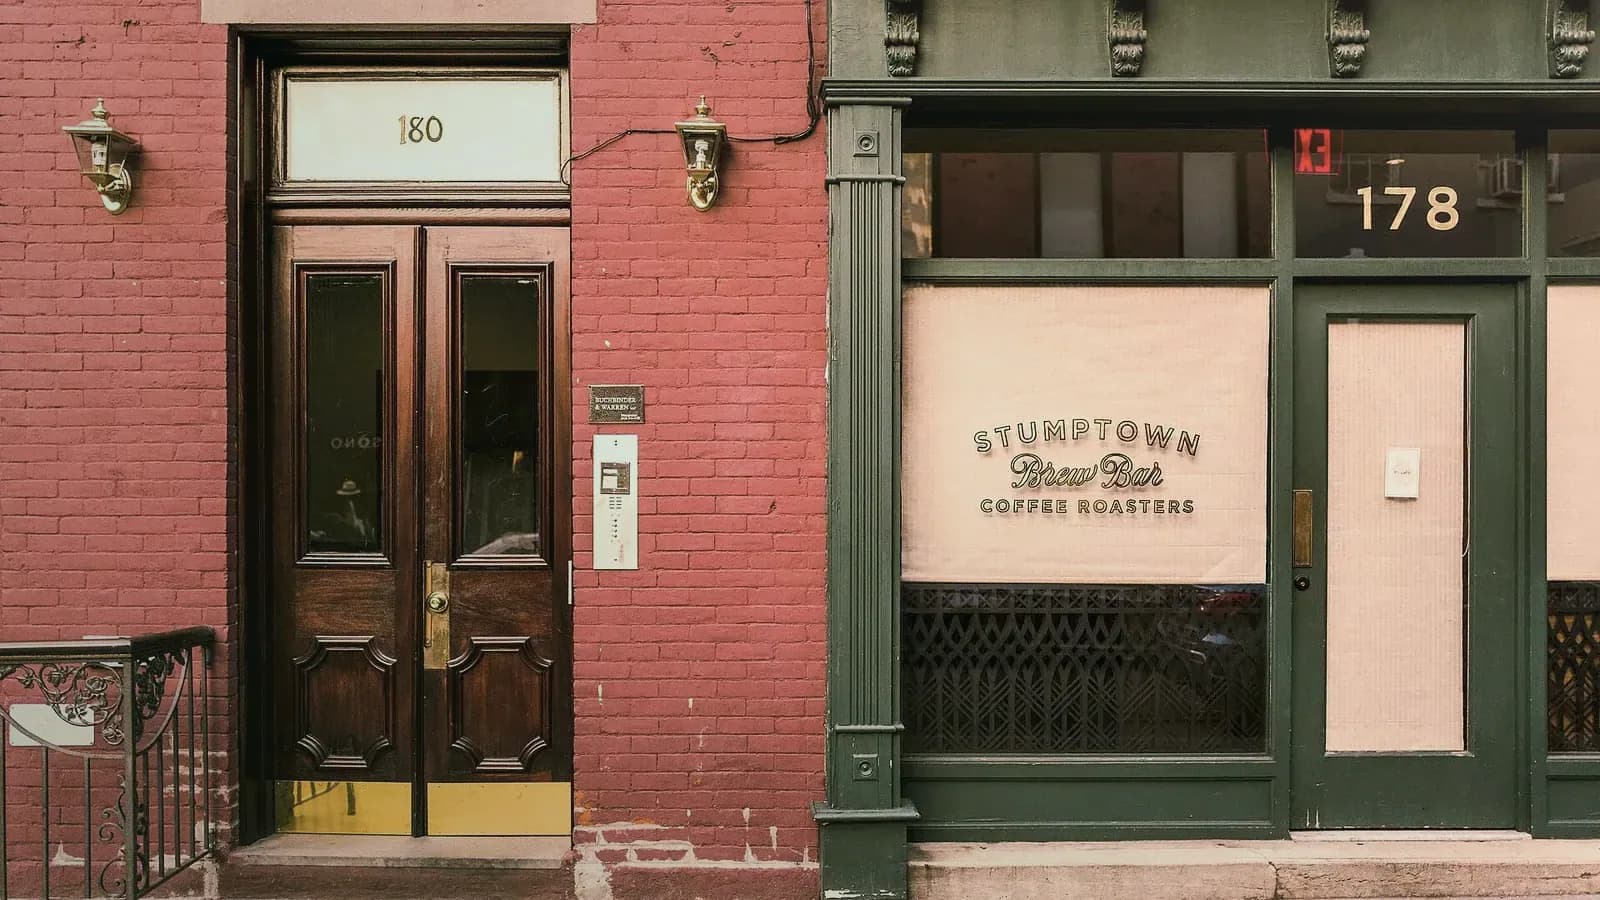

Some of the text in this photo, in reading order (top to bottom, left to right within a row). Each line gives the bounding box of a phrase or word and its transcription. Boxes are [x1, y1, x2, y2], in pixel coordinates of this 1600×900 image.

[398, 115, 443, 144] 180
[1357, 186, 1459, 231] 178
[973, 418, 1200, 456] STUMPTOWN
[1010, 453, 1164, 489] Brew Bar
[980, 499, 1194, 513] COFFEE ROASTERS
